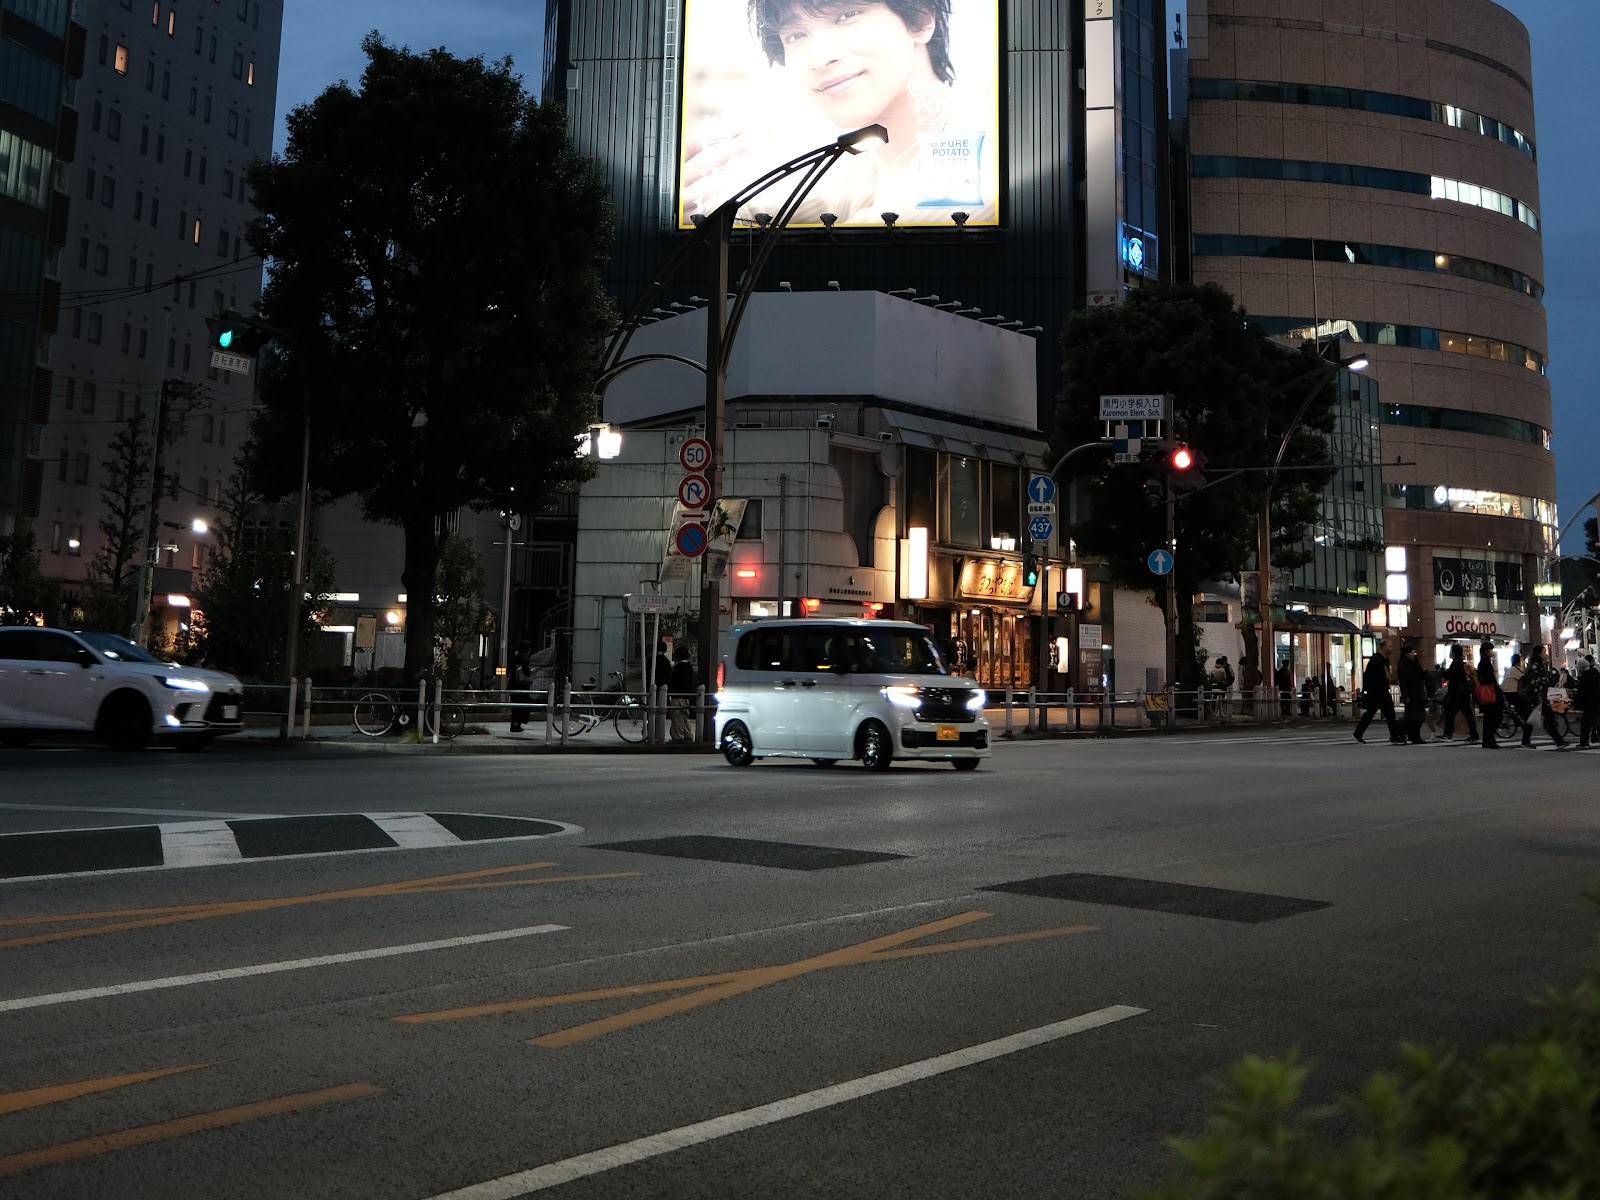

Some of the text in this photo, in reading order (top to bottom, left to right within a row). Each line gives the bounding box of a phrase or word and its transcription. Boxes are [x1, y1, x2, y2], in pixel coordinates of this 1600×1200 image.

[941, 139, 968, 148] PURE
[933, 148, 970, 157] POTATO
[1103, 398, 1160, 408] 黒門小学校入口
[1102, 408, 1161, 417] Kuromon Elem. Sch.
[687, 448, 704, 463] 50
[1031, 522, 1050, 533] 437
[1446, 615, 1496, 634] docomo
